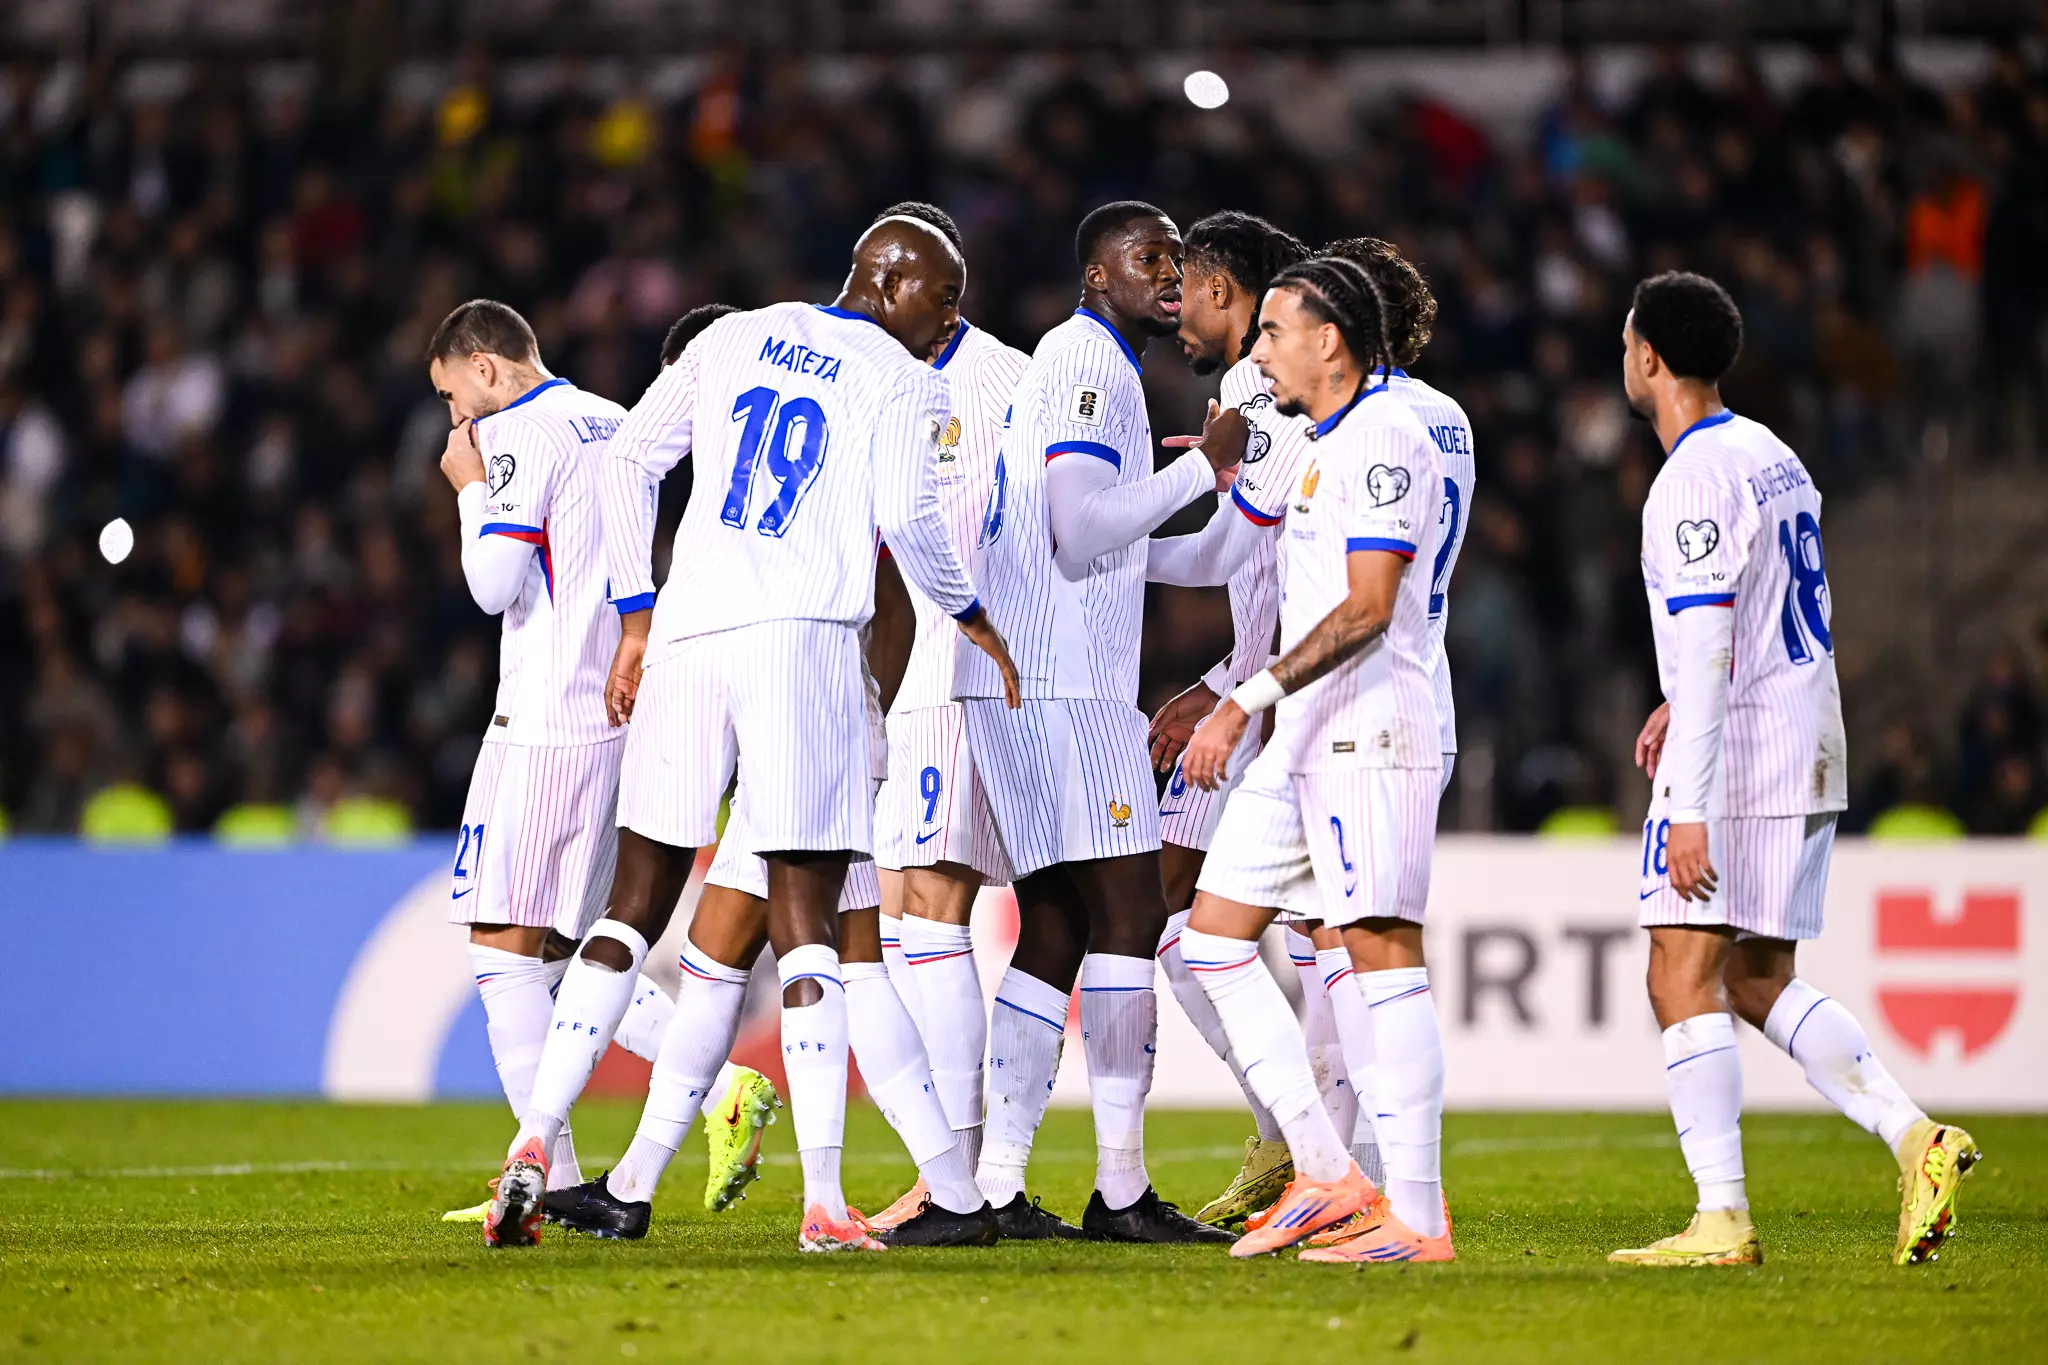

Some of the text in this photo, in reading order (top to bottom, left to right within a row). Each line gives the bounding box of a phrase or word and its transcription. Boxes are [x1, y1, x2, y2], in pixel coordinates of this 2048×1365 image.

[758, 336, 842, 383] MATETA
[568, 416, 624, 444] L.HERN
[1428, 426, 1470, 455] NDEZ
[720, 386, 829, 539] 19
[1778, 512, 1833, 665] 18
[920, 766, 943, 824] 9
[453, 823, 485, 880] 21
[1642, 818, 1670, 877] 18
